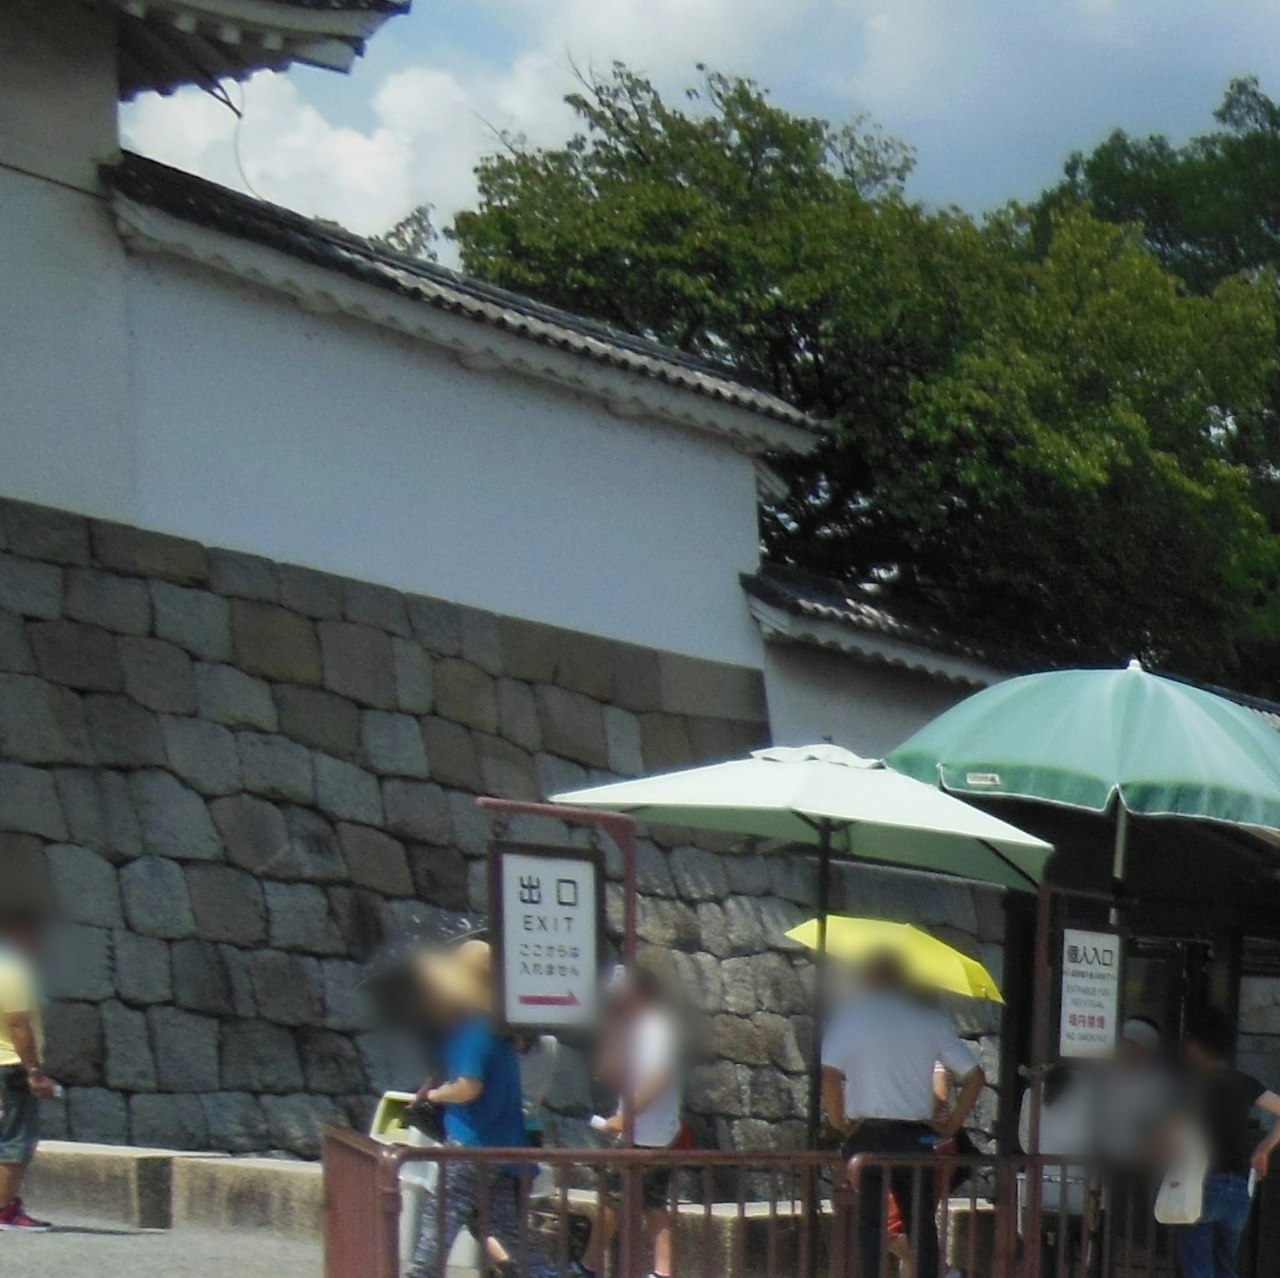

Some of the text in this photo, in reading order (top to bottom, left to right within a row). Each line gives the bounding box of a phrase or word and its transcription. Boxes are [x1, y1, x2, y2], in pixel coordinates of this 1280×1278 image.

[519, 875, 579, 907] 出口
[522, 914, 576, 933] EXIT
[519, 943, 581, 959] ここからは
[519, 961, 581, 977] 入れません
